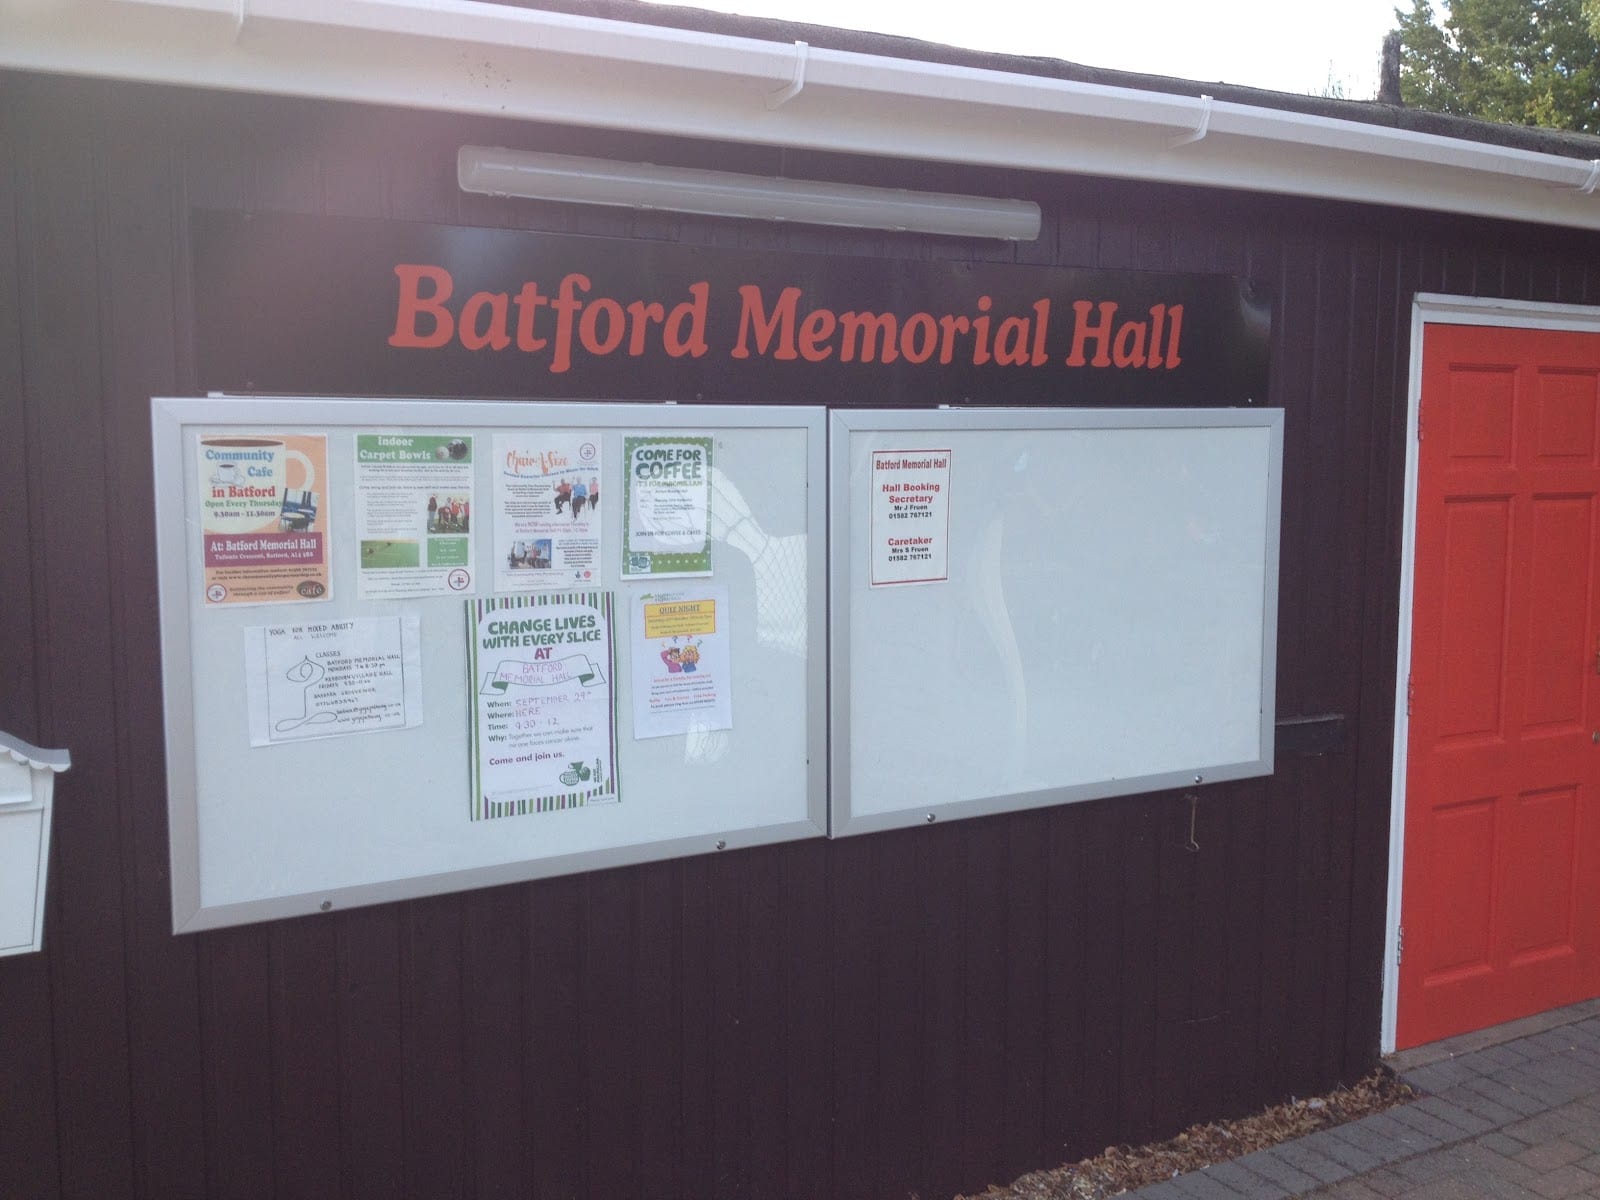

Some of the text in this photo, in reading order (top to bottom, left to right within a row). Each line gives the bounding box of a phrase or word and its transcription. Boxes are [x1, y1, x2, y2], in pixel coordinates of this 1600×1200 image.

[388, 263, 1184, 373] Batford Memorial Hall
[378, 436, 414, 446] Indoor
[206, 449, 275, 462] Community
[359, 450, 431, 461] Carpet Bowls
[636, 449, 701, 461] COME FOR
[876, 458, 947, 470] Batford Memorial Hall
[247, 467, 273, 477] Cafe
[635, 461, 702, 480] COFFEE
[212, 486, 276, 498] in Batford
[882, 483, 940, 493] Hall Booking
[205, 500, 224, 509] Open
[226, 500, 247, 508] Every
[889, 495, 933, 504] Secretary
[211, 539, 316, 552] At: Batford Memorial Hall
[888, 537, 932, 546] Caretaker
[678, 604, 700, 613] NIGHT
[307, 624, 328, 633] MIXED
[330, 622, 354, 631] ABILITY
[487, 615, 596, 635] CHANGE LIVES
[483, 629, 601, 650] WITH EVERY SLICE
[534, 647, 552, 660] AT
[354, 656, 385, 664] MEMORIAL
[522, 662, 563, 674] BATFORD
[499, 671, 572, 683] MEMORIAL HALL
[486, 700, 512, 709] When:
[515, 694, 569, 707] SEPTEMBER
[487, 707, 541, 720] Where: HERE
[488, 723, 508, 731] Time:
[488, 734, 508, 744] Why:
[509, 731, 533, 741] Together
[489, 751, 565, 766] Come and join us.
